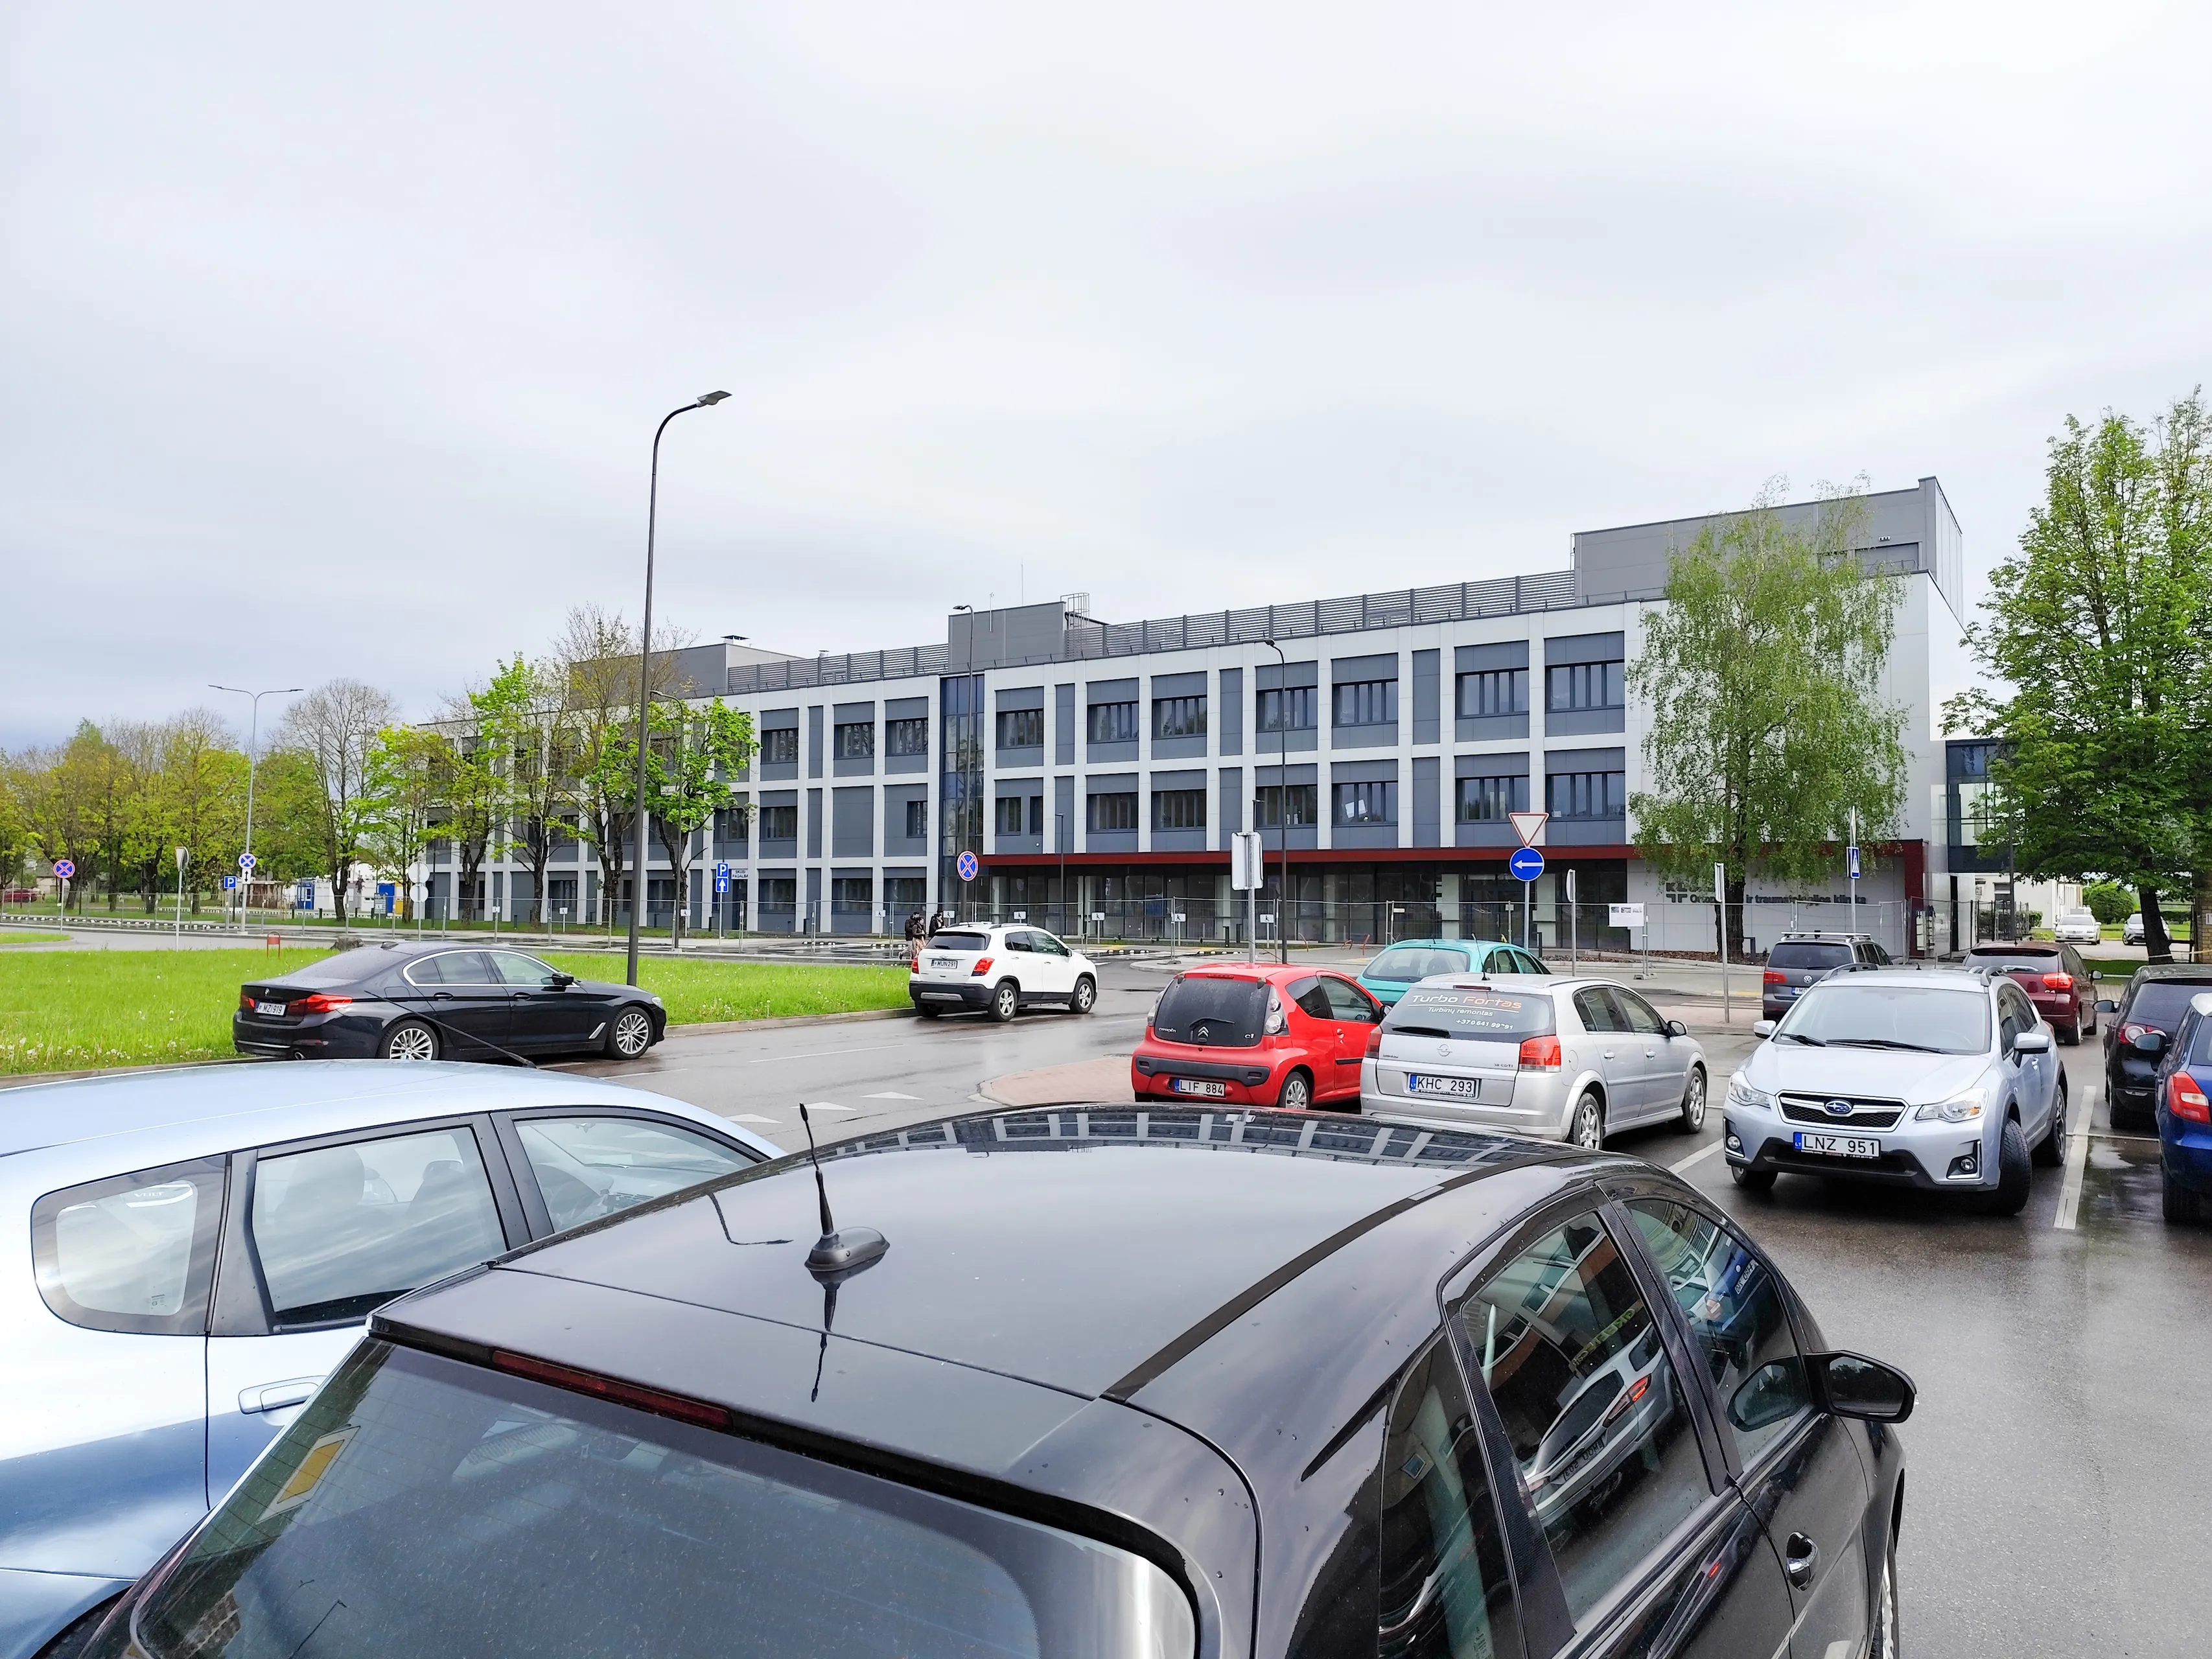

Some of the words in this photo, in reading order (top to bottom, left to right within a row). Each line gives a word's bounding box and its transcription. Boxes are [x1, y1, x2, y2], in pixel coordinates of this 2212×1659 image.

[719, 864, 727, 876] P
[227, 877, 234, 887] P
[1746, 894, 1754, 903] ir
[1834, 894, 1867, 905] klinka
[1412, 994, 1458, 1003] Turbo
[1462, 996, 1522, 1009] Fortas
[1456, 1008, 1494, 1017] remontas
[1180, 1080, 1199, 1091] LIF
[1205, 1083, 1223, 1095] 884
[1417, 1077, 1442, 1089] KHC
[1450, 1080, 1473, 1093] 293
[1804, 1135, 1836, 1151] LNZ
[1848, 1140, 1874, 1155] 951
